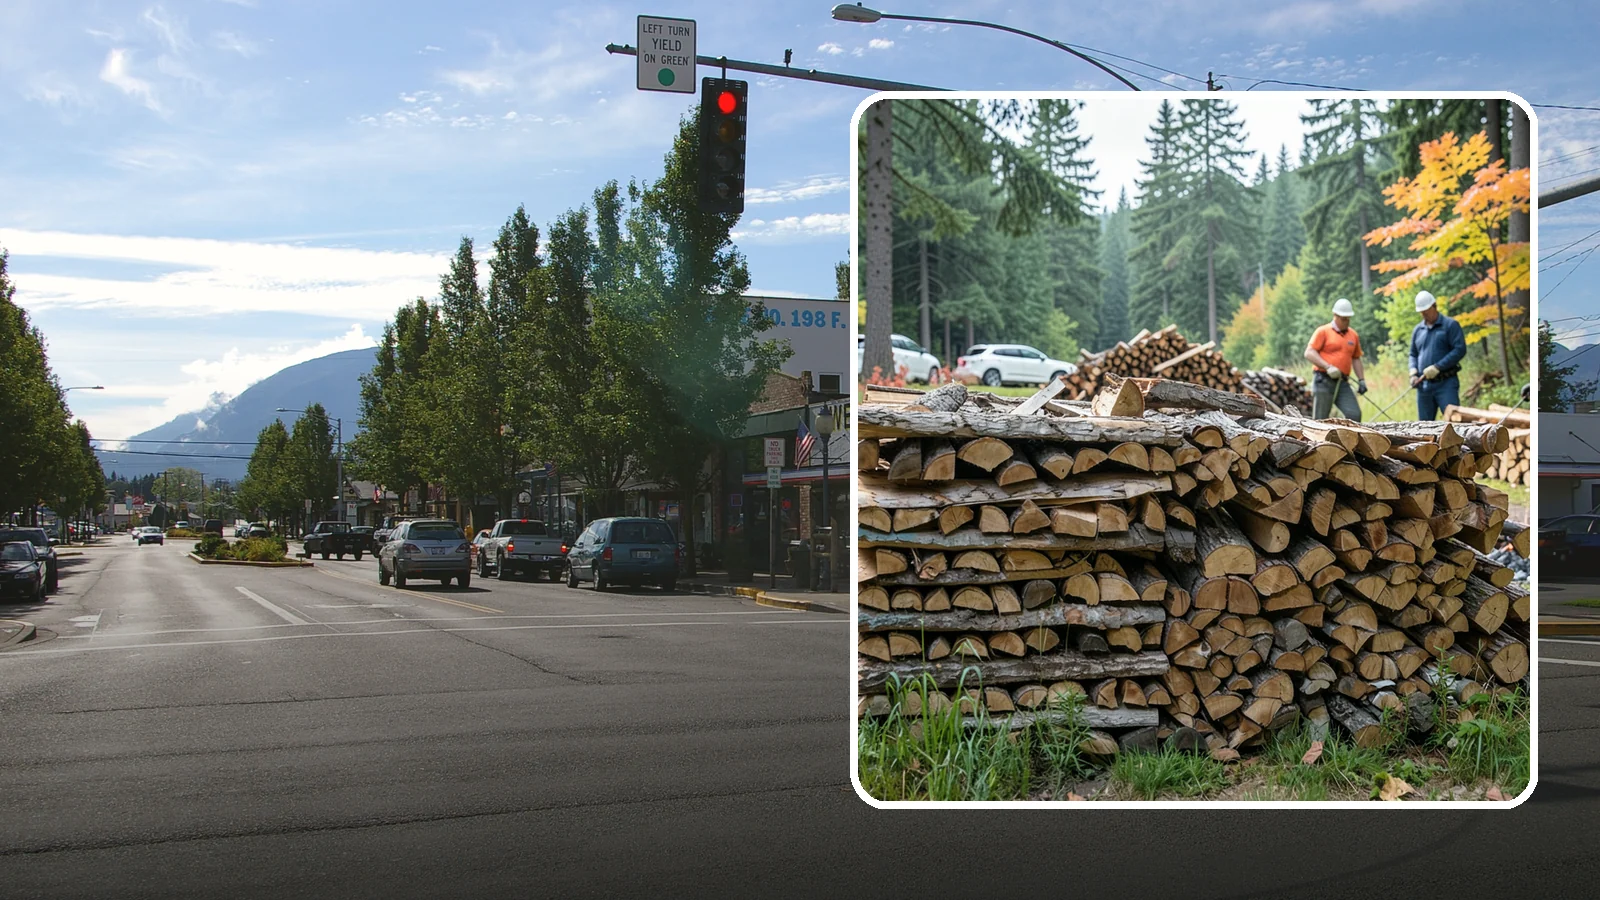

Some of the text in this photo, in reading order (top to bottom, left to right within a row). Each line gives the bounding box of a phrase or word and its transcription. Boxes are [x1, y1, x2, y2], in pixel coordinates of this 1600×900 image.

[643, 24, 690, 36] LEFT TURN
[652, 38, 681, 51] YIELD
[644, 54, 689, 66] ON GREEN
[791, 309, 826, 328] 198
[831, 311, 846, 329] F.
